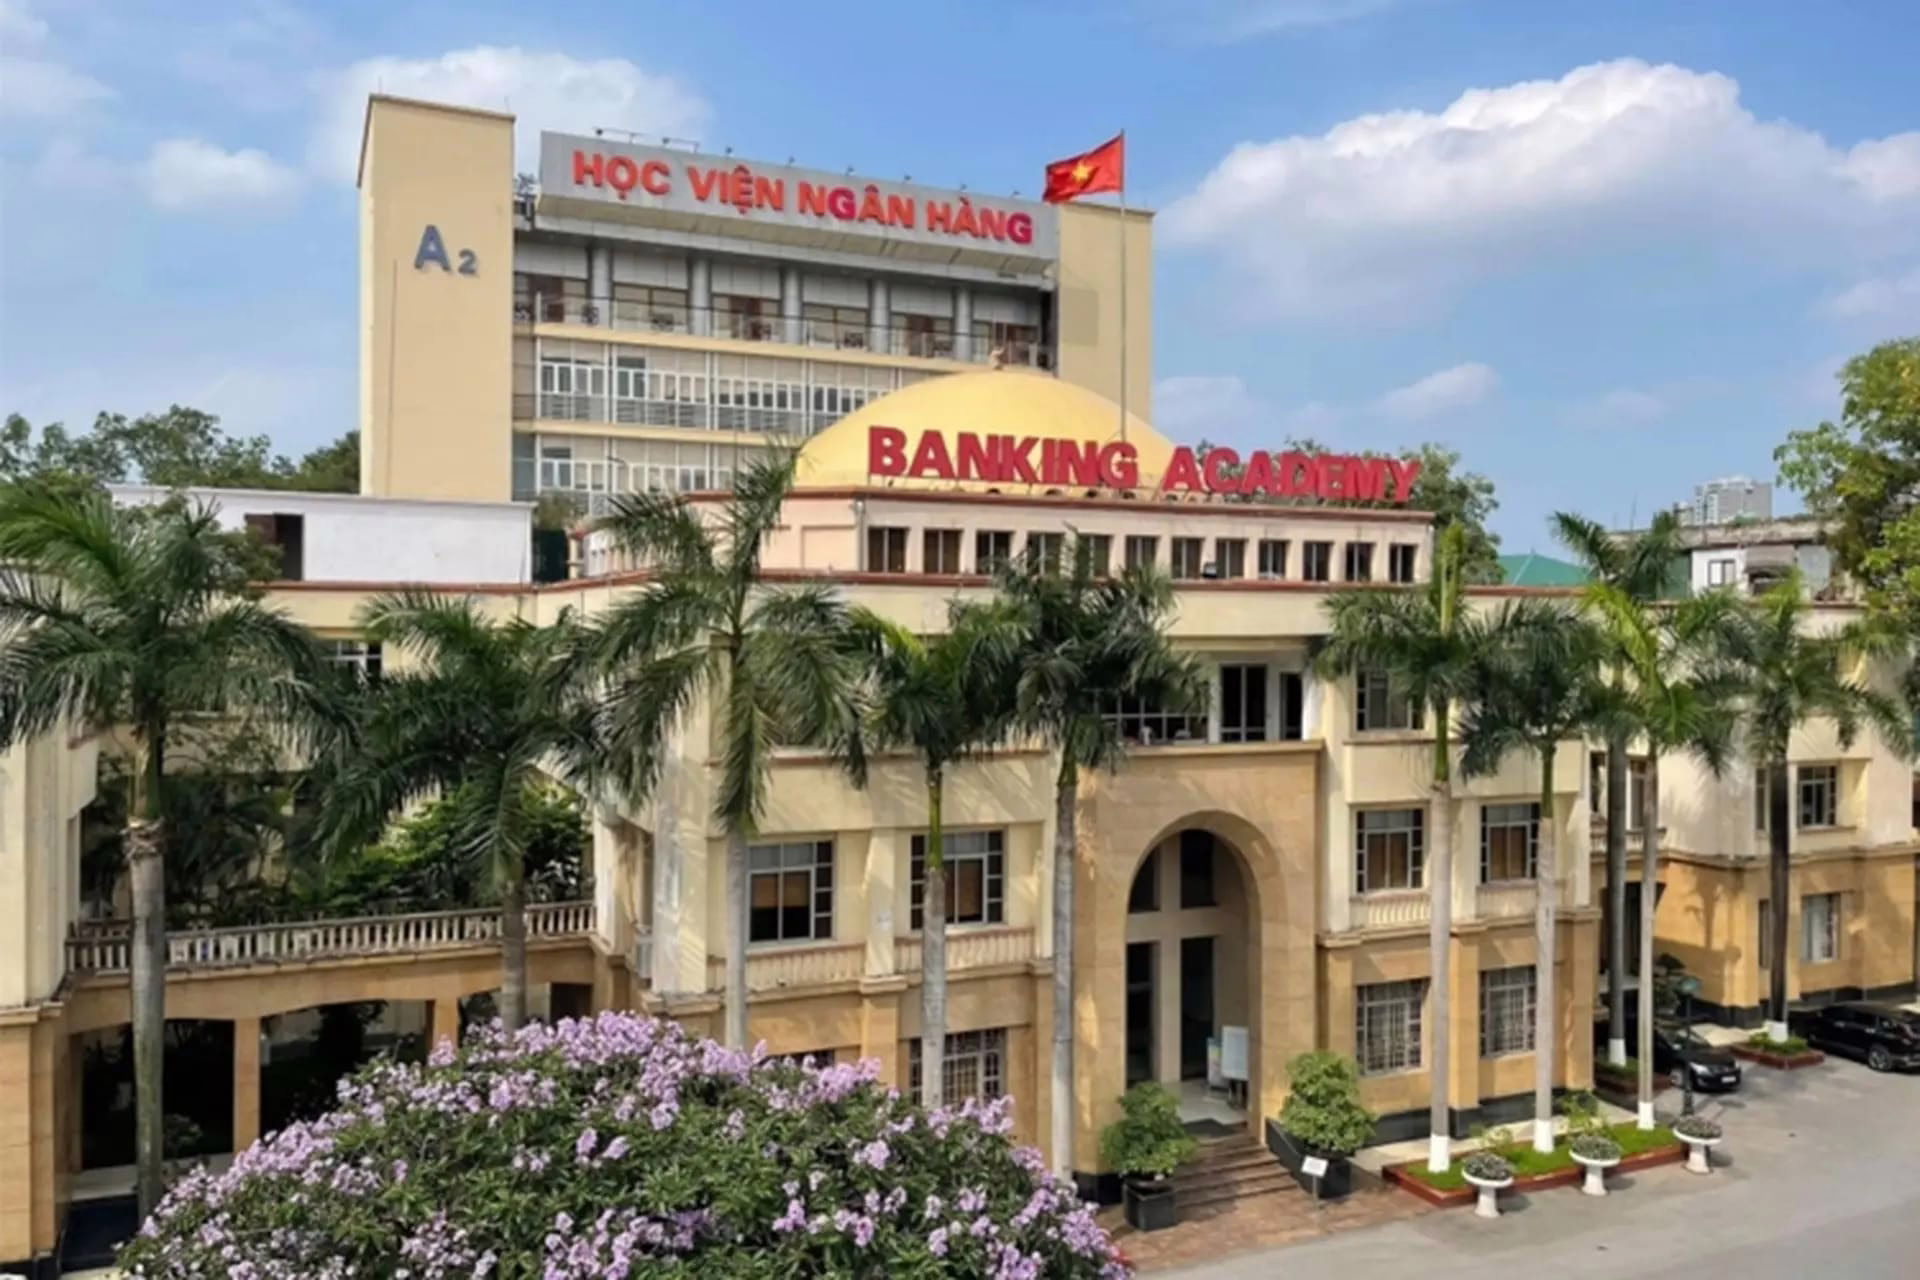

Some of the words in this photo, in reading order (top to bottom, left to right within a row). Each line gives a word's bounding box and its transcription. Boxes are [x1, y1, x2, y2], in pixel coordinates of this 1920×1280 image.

[573, 150, 671, 201] HỌC
[688, 166, 786, 215] VIỆN
[797, 183, 914, 229] NGÂN
[927, 198, 1033, 244] HÀNG
[414, 224, 476, 275] A2
[868, 427, 1139, 489] BANKING
[1162, 447, 1420, 502] ACADEMY
